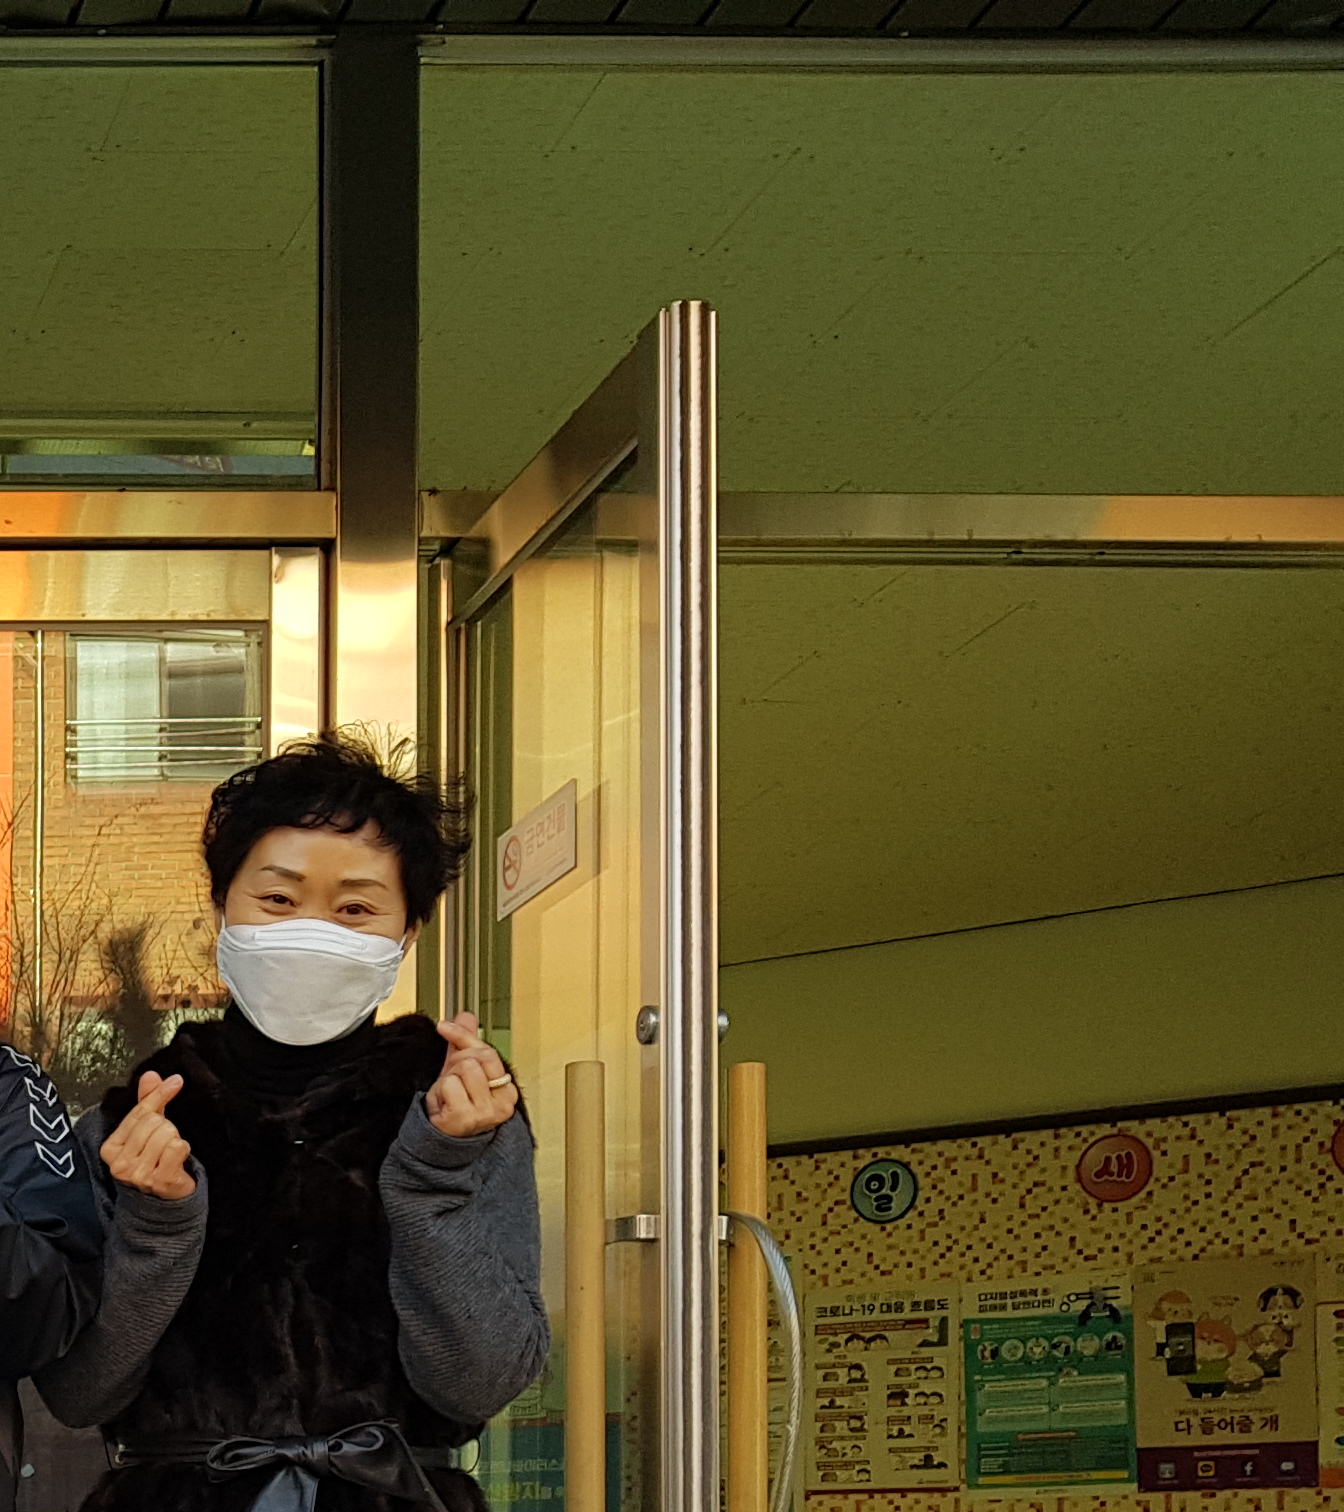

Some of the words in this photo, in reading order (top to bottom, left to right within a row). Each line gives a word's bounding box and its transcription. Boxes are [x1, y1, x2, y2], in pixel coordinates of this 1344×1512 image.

[1092, 1149, 1136, 1181] 새
[863, 1168, 901, 1213] 일
[816, 1303, 876, 1318] 코로나-19
[910, 1299, 950, 1312] 흐름도
[1174, 1417, 1193, 1435] 다
[1259, 1413, 1280, 1432] 개
